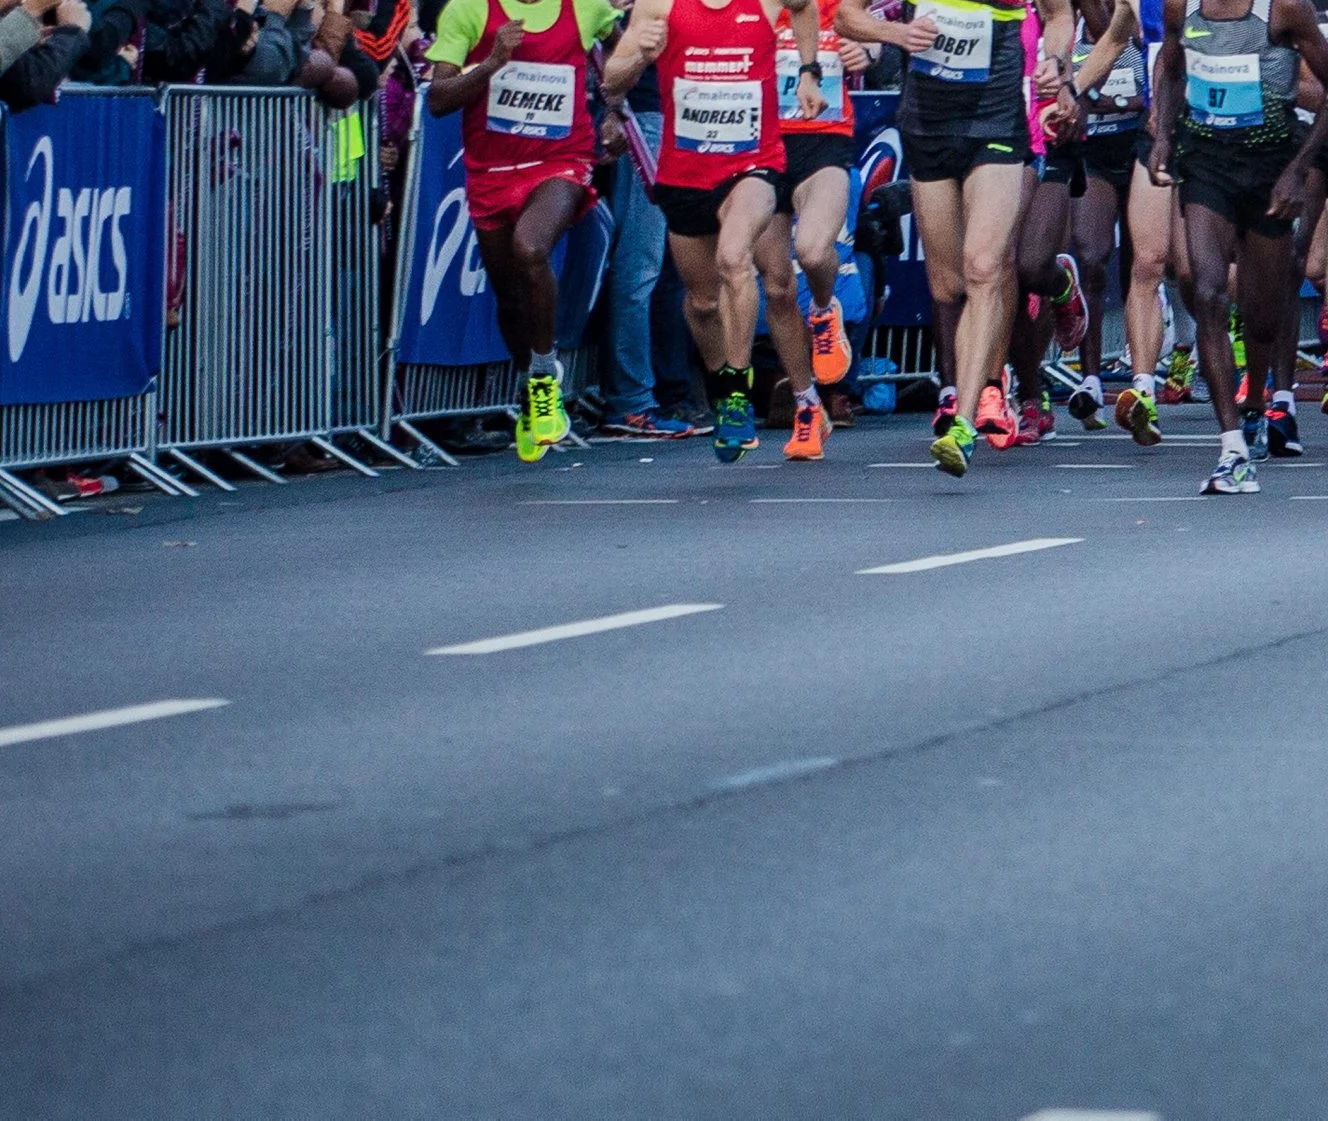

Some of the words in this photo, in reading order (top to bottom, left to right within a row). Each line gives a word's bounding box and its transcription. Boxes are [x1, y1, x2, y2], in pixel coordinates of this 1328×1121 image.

[933, 33, 980, 57] OBBY
[496, 88, 567, 113] DEMEKE
[1208, 87, 1228, 109] 97
[681, 106, 747, 125] ANDREAS
